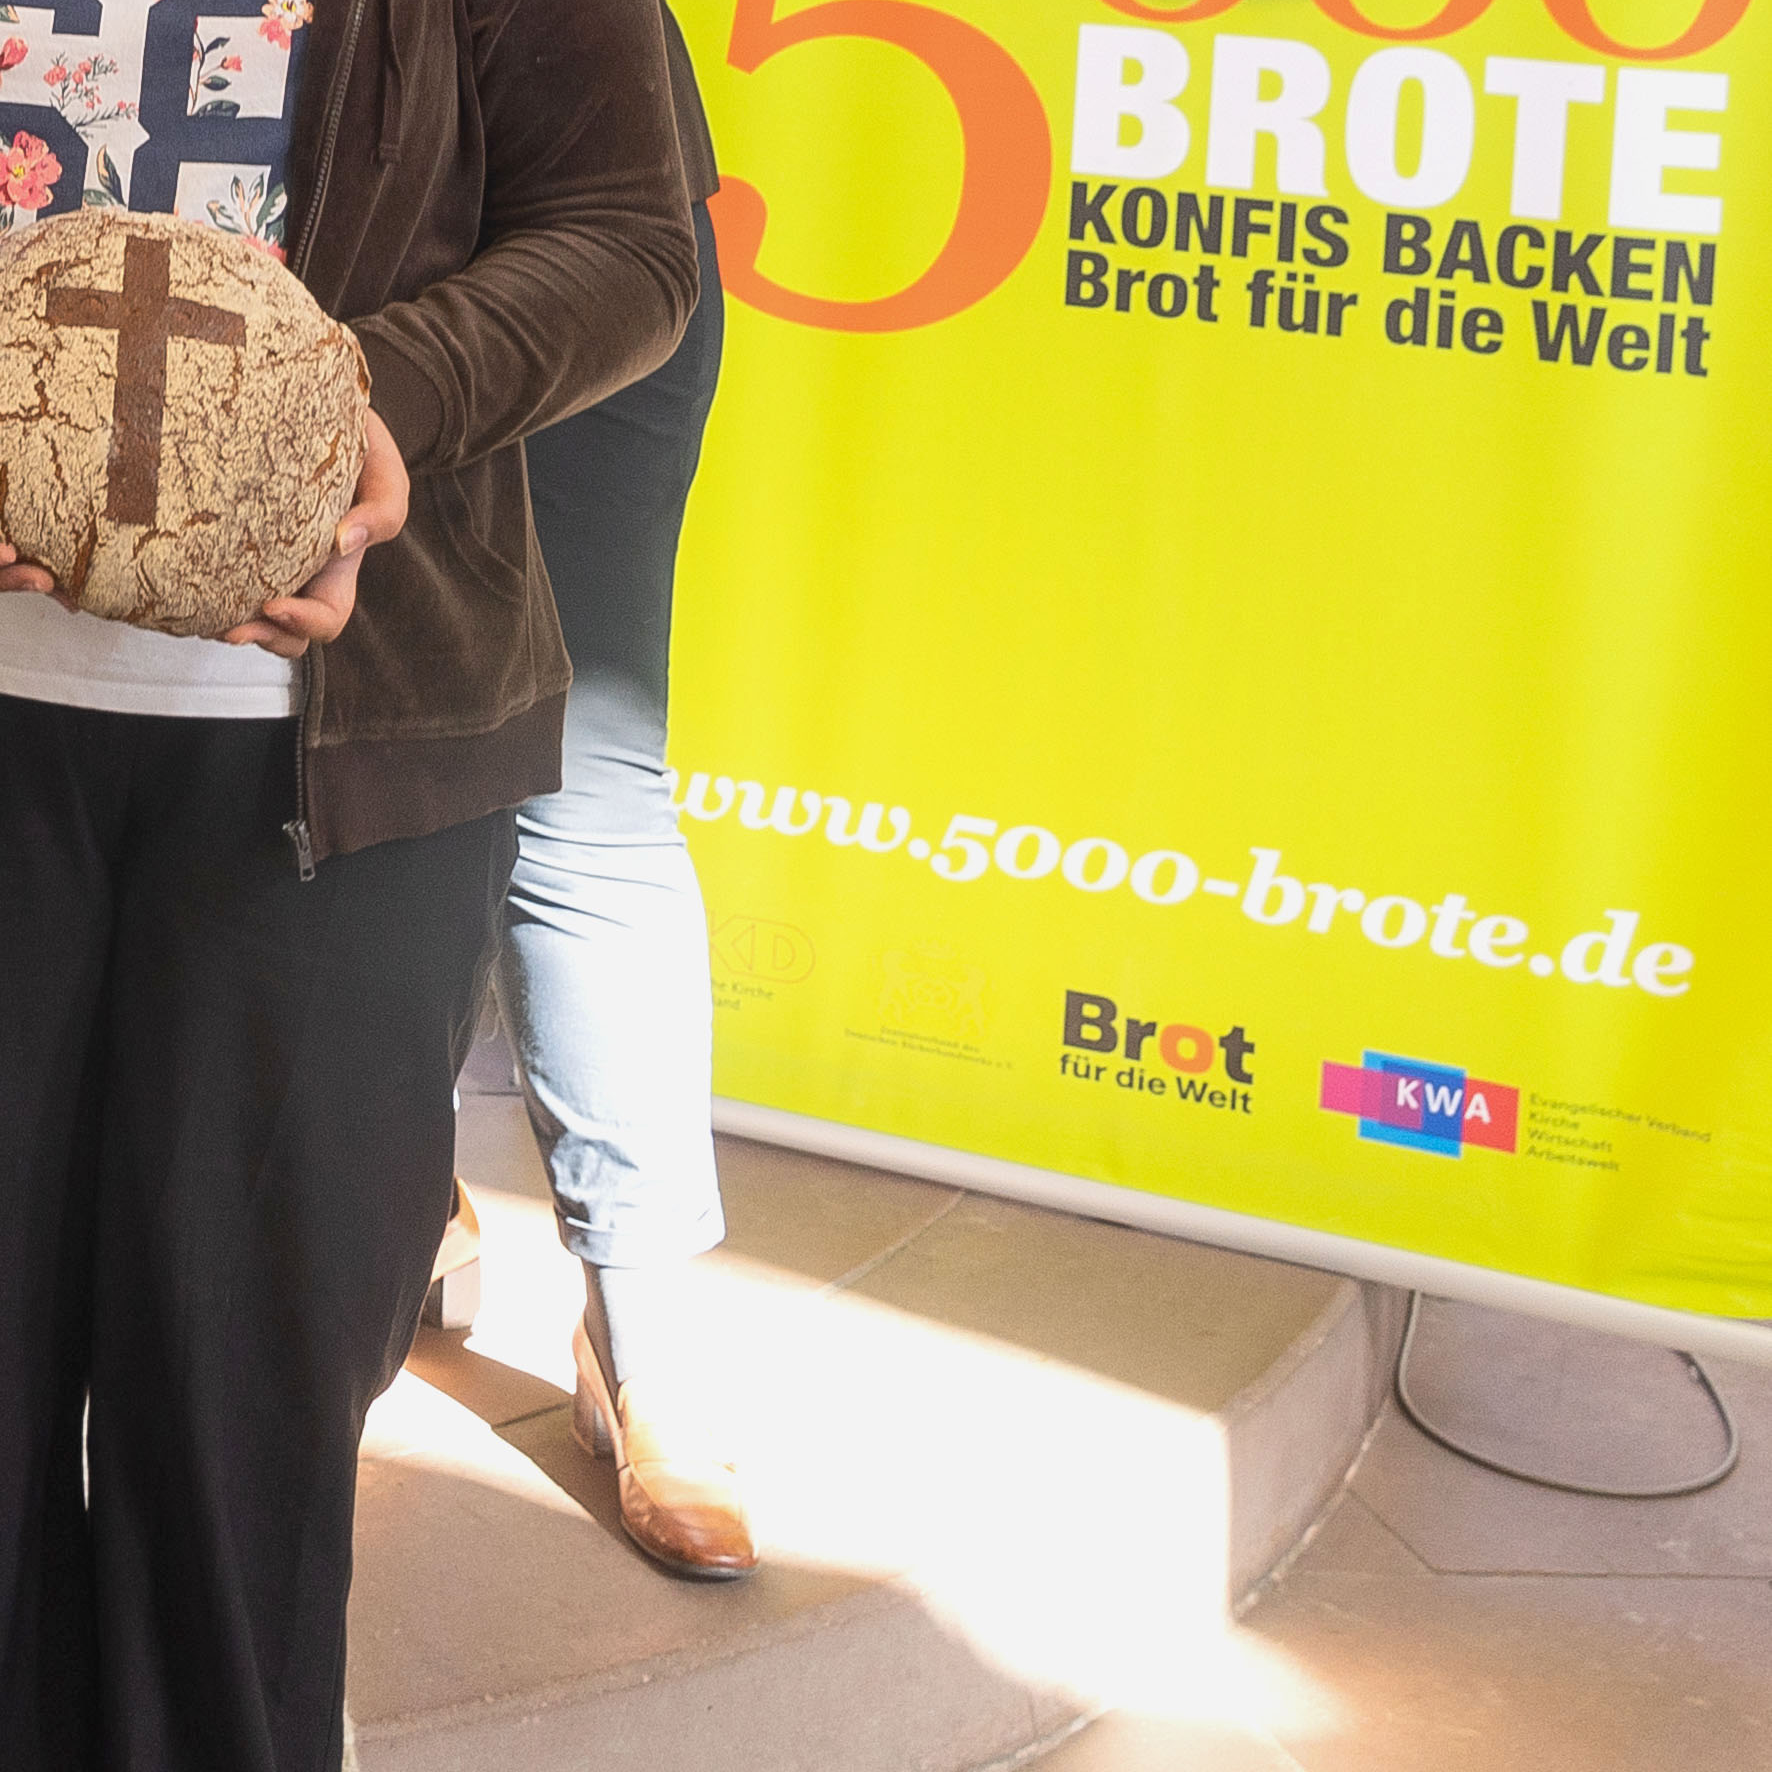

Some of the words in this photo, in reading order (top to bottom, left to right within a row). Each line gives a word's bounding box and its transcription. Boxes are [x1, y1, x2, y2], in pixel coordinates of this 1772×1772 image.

[1070, 22, 1730, 235] BROTE
[1068, 180, 1350, 267] KONFIS
[1380, 212, 1717, 306] BACKEN
[1064, 248, 1220, 325] Brot
[1245, 267, 1358, 339] für
[1382, 284, 1504, 356] die
[1533, 305, 1712, 378] Welt
[662, 766, 1695, 999] www.5000-brote.de
[1060, 1053, 1107, 1082] für
[1116, 1066, 1166, 1096] die
[1176, 1076, 1253, 1115] Welt
[1063, 989, 1255, 1085] Brot
[1396, 1076, 1492, 1124] KWA
